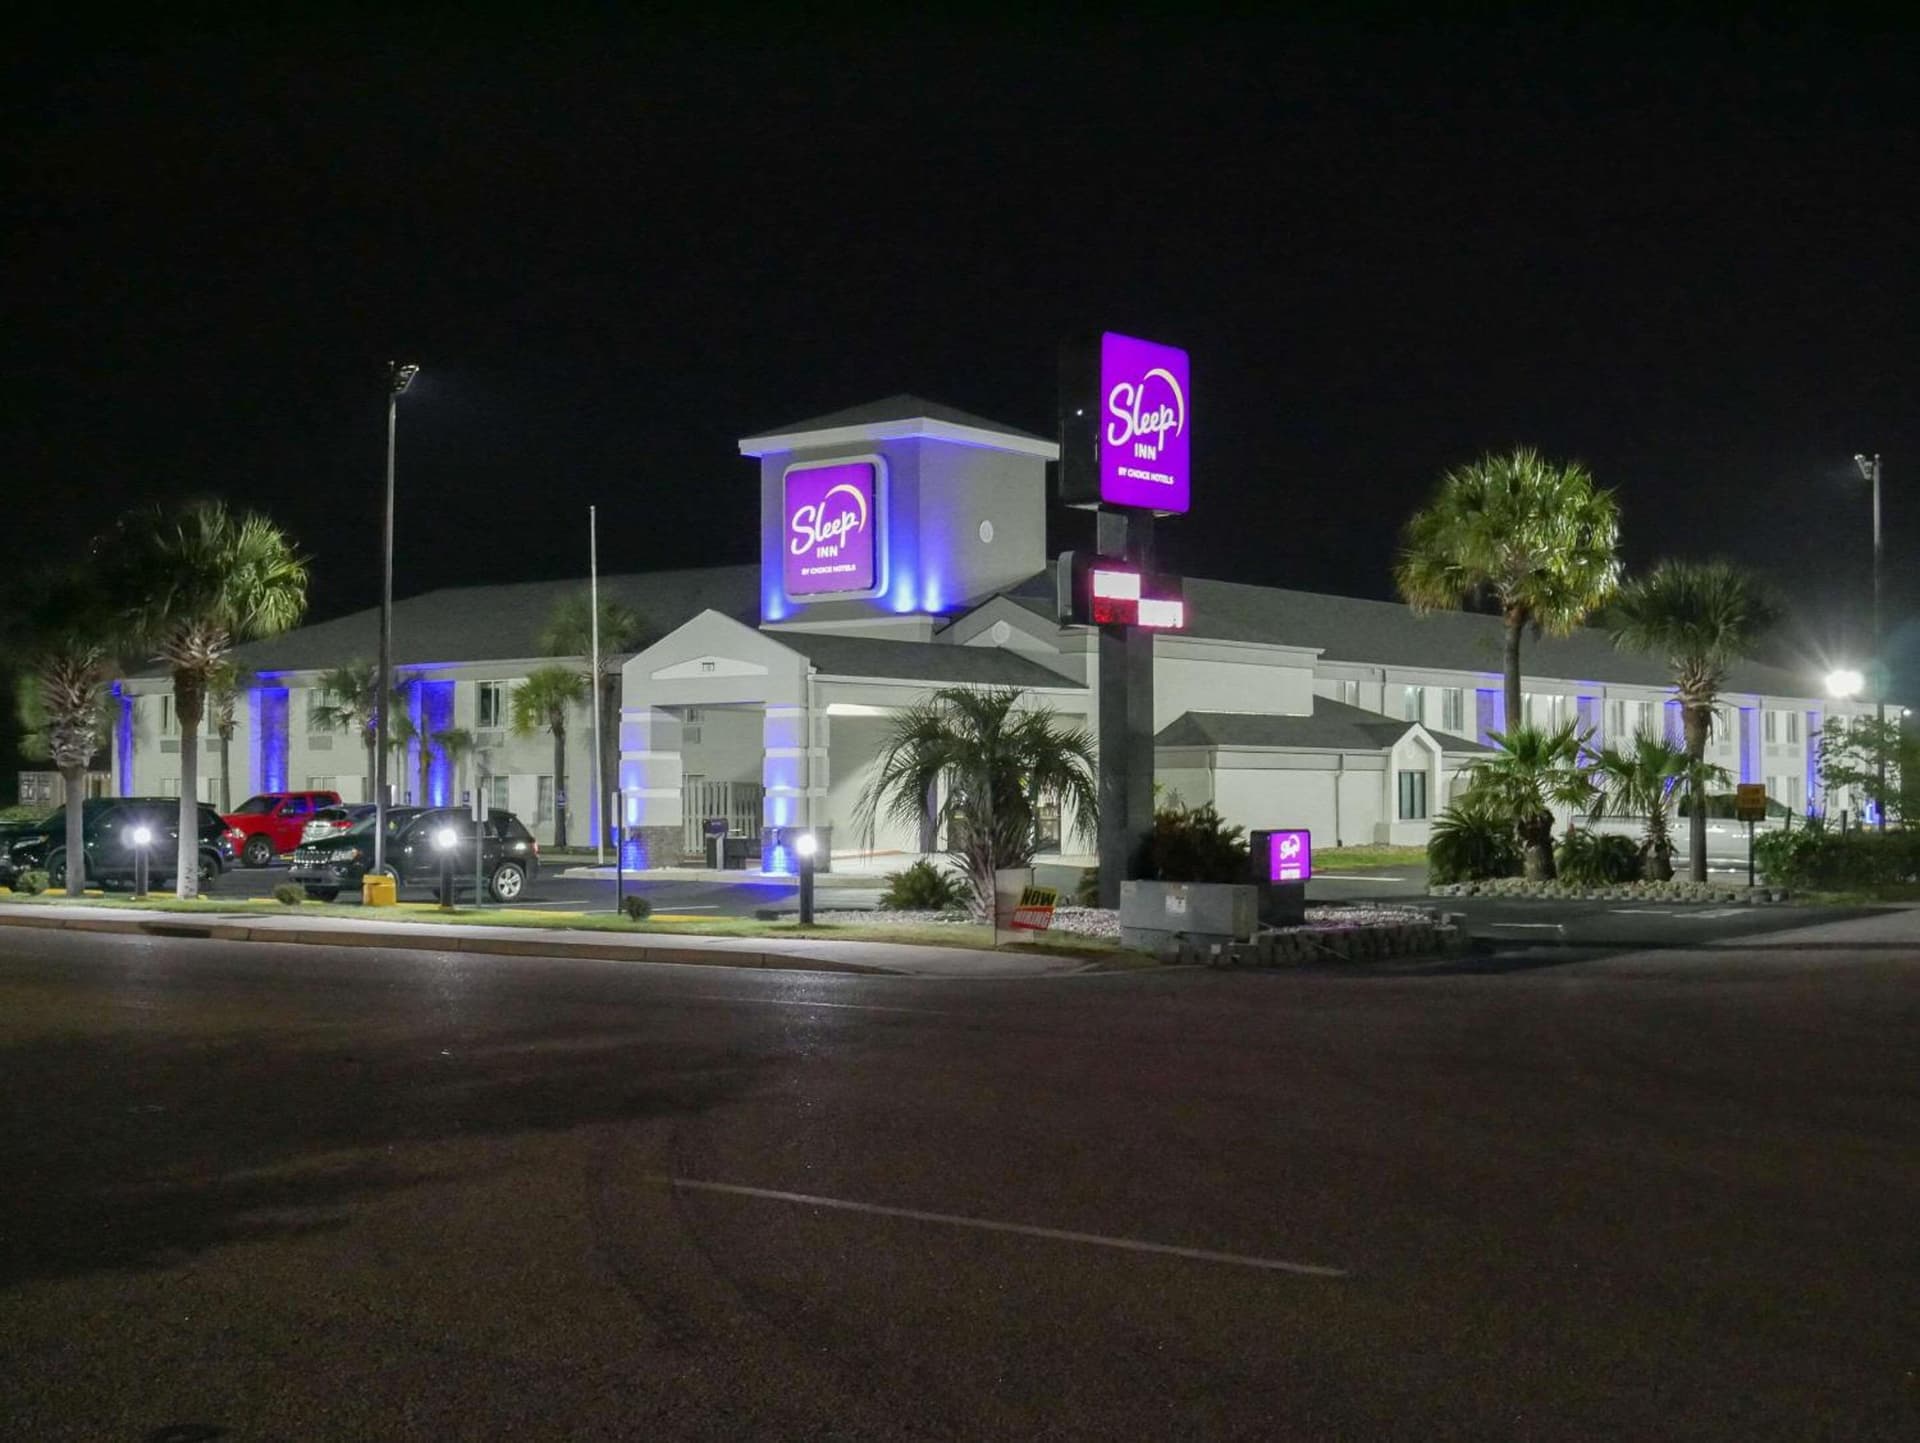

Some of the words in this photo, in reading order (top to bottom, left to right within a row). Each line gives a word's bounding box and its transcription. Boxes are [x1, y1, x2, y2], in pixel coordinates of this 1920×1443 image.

[1107, 382, 1177, 451] Sleep
[1134, 442, 1157, 461] INN
[1118, 466, 1127, 476] BY
[790, 501, 860, 555] Sleep
[816, 545, 839, 559] INN
[1020, 887, 1056, 906] NOW
